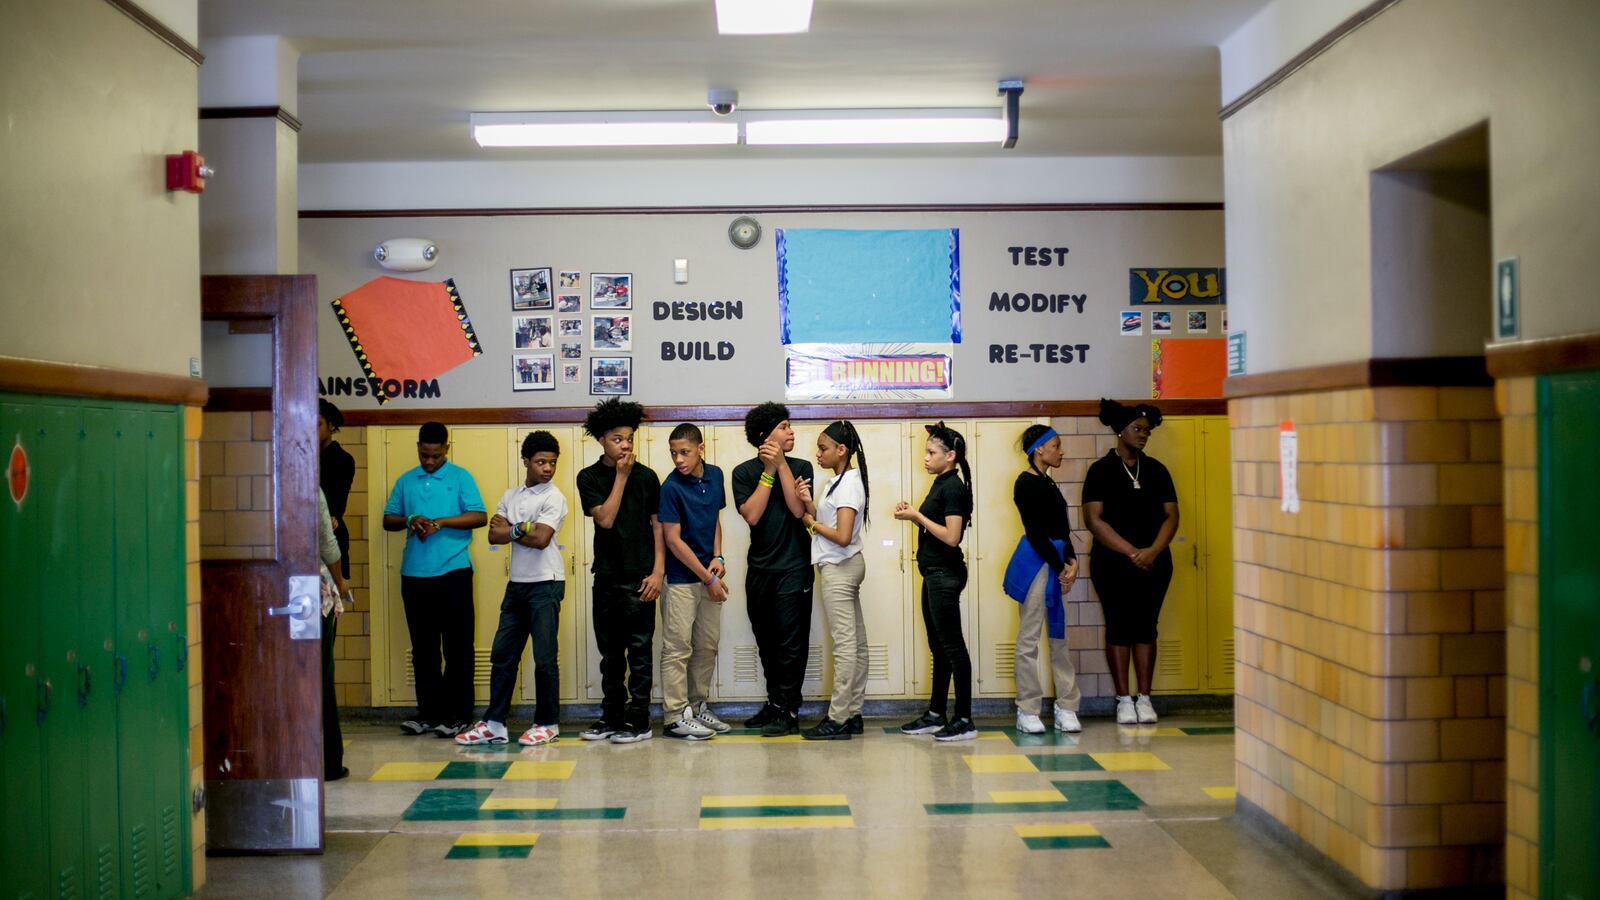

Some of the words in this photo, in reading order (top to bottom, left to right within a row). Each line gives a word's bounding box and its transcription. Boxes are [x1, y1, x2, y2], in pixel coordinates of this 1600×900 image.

[1007, 246, 1070, 267] TEST
[652, 300, 743, 321] DESIGN
[988, 292, 1088, 315] MODIFY
[661, 341, 735, 361] BUILD
[989, 343, 1091, 364] RE-TEST
[831, 360, 945, 384] RUNNING!
